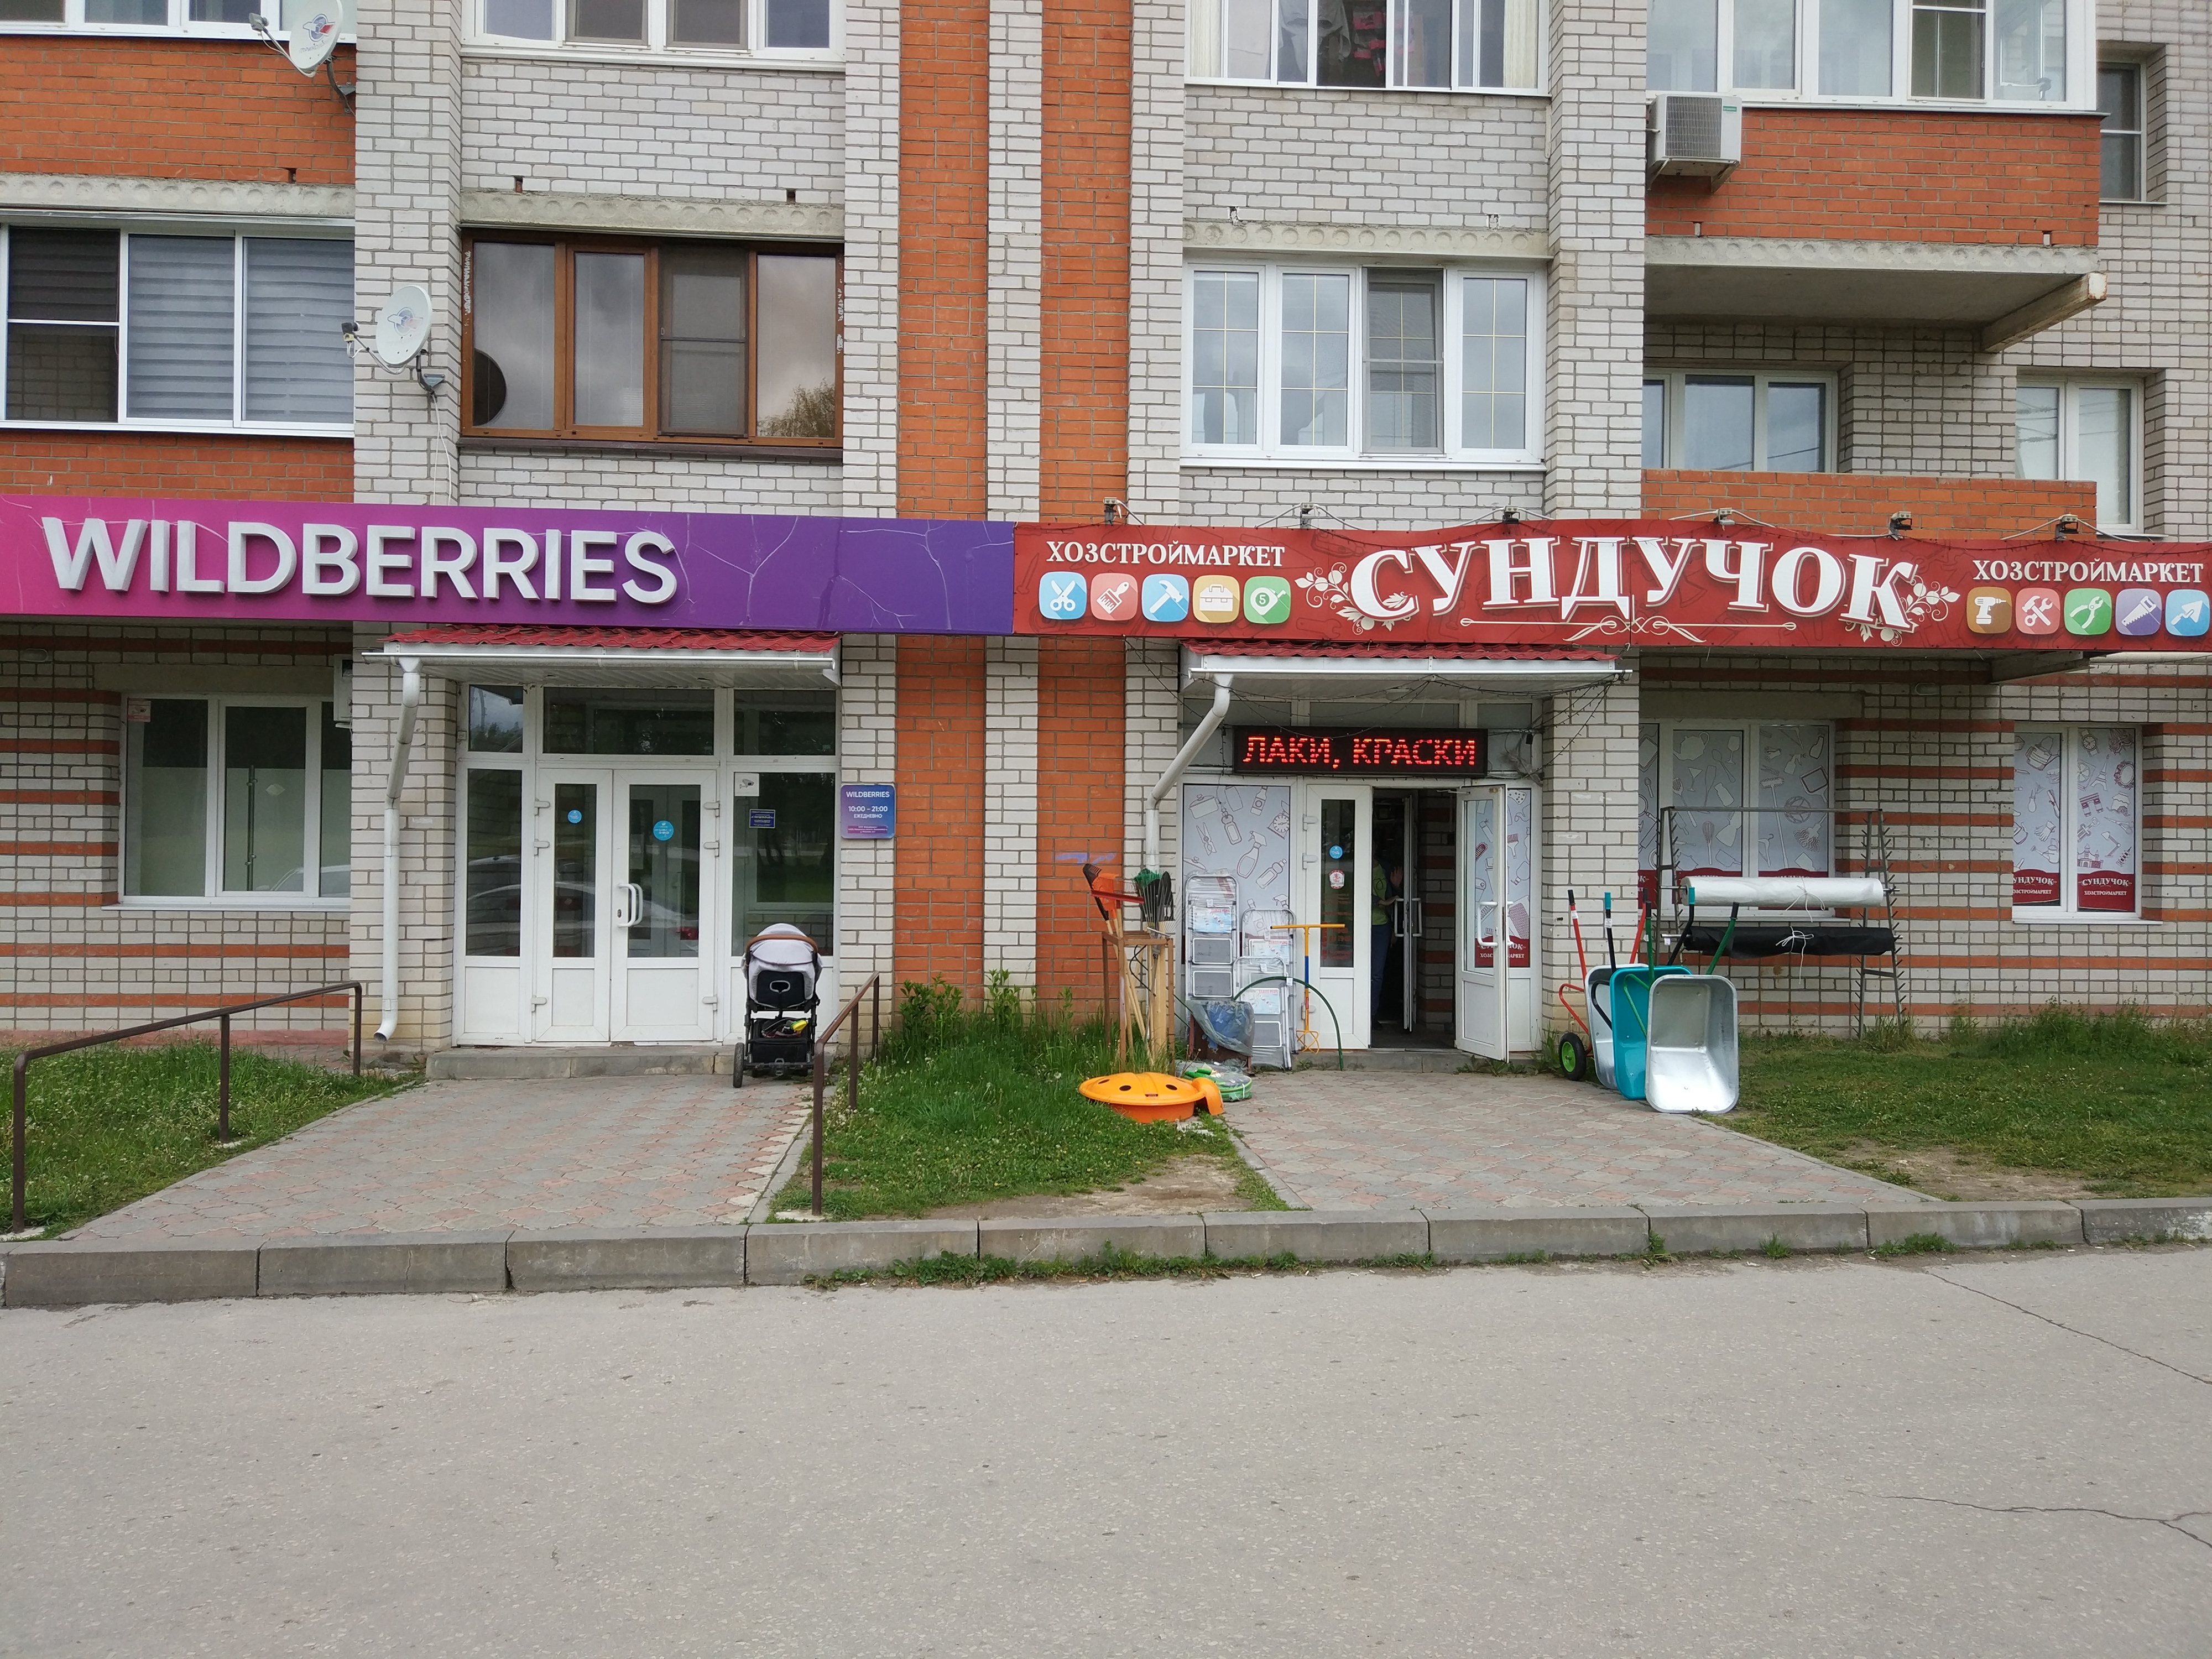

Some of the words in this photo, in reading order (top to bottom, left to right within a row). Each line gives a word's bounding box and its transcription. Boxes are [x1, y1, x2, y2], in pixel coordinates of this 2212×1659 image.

[41, 517, 677, 605] WILDBERRIES
[1046, 540, 1285, 566] ХОЗСТРОЙМАРКЕТ
[1973, 558, 2203, 583] ХОЗСТРОЙМАРКЕТ
[1350, 536, 1918, 633] СУНДУЧОК
[1242, 737, 1340, 769] ЛАКИ,
[1353, 738, 1475, 765] КРАСКИ
[2013, 877, 2054, 886] УНДУЧОК
[2081, 878, 2129, 886] СУНДУЧОК
